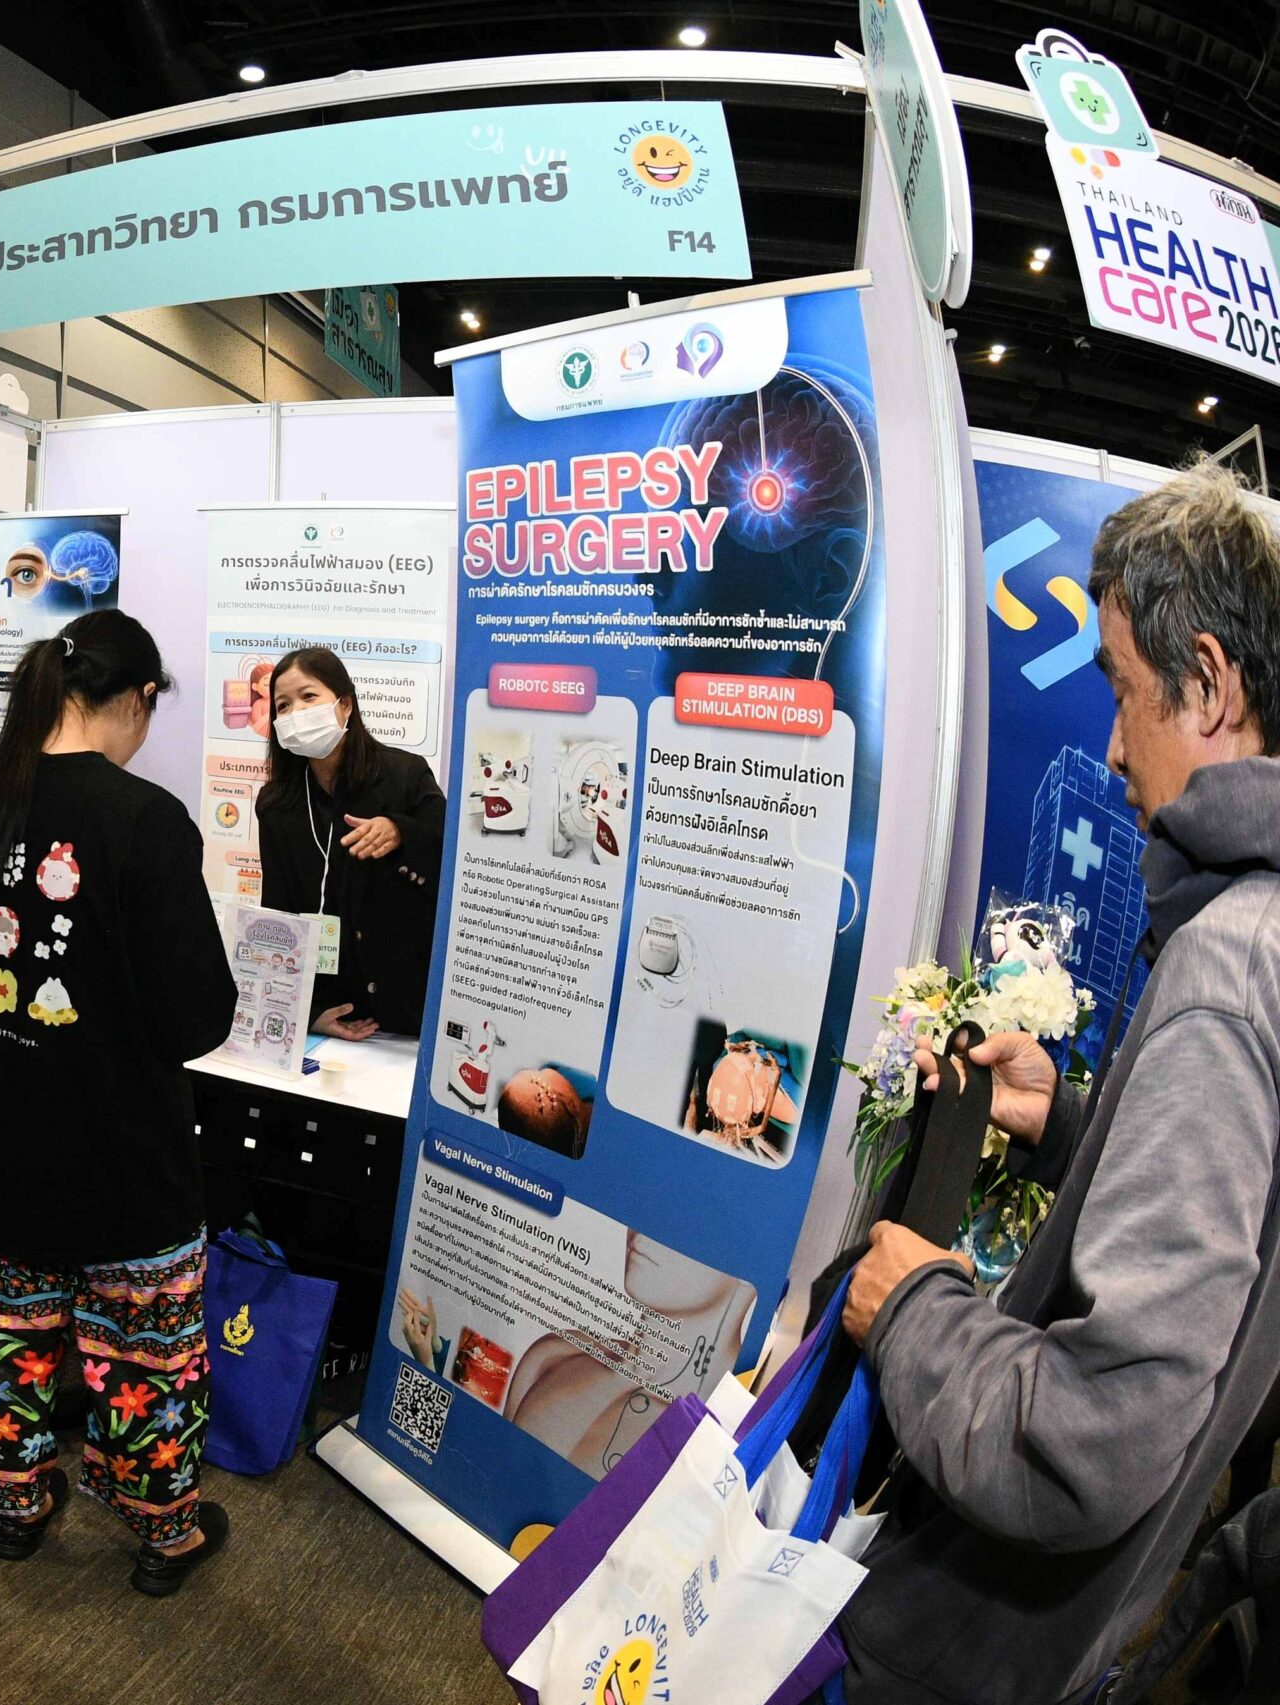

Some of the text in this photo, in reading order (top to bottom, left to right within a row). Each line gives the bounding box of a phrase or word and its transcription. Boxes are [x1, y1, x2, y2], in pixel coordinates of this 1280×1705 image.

[614, 120, 708, 154] LONGEVITY
[238, 160, 569, 232] กรมการแพทย์
[1076, 181, 1183, 227] THAILAND
[668, 230, 716, 253] F14
[1084, 205, 1280, 320] HEALTH
[1098, 267, 1218, 343] care
[332, 322, 392, 396] สาธารณสุข
[465, 441, 723, 523] EPILEPSY
[463, 508, 728, 579] SURGERY
[221, 551, 434, 575] การตรวจคลื่นไฟฟ้าสมอง (EEG)
[245, 574, 405, 595] เพื่อการวินิจฉัยและรักษา
[468, 582, 655, 598] การผ่าตัดรักษาโรคลมชักครบวงจร
[345, 605, 379, 615] Diagnosis
[382, 606, 396, 614] and
[398, 607, 436, 616] Treatment
[476, 614, 516, 627] Epilepsy
[515, 616, 549, 627] surgery
[341, 640, 372, 655] (EEG)
[375, 642, 417, 655] คืออะไร?
[351, 676, 415, 686] การตรวจบันทึก
[499, 678, 585, 695] ROBOTC SEEG
[707, 682, 795, 702] DEEP BRAIN
[682, 699, 824, 728] STIMULATION (DBS)
[367, 727, 406, 739] รคลมชัก)
[219, 761, 273, 775] ประเภทการ
[650, 748, 845, 788] Deep Brain Stimulation
[477, 873, 504, 886] Robotic
[580, 894, 619, 910] Assistant
[583, 878, 607, 890] ROSA
[591, 914, 609, 925] GPS
[450, 988, 527, 1020] thermocoagulation)
[452, 973, 572, 1017] (SEEG-guided radiofrequency
[434, 1140, 553, 1202] Vagal Nerve Stimulation
[424, 1173, 590, 1266] Vagal Nerve Stimulation (VNS)
[625, 1614, 670, 1702] LONGEVIT
